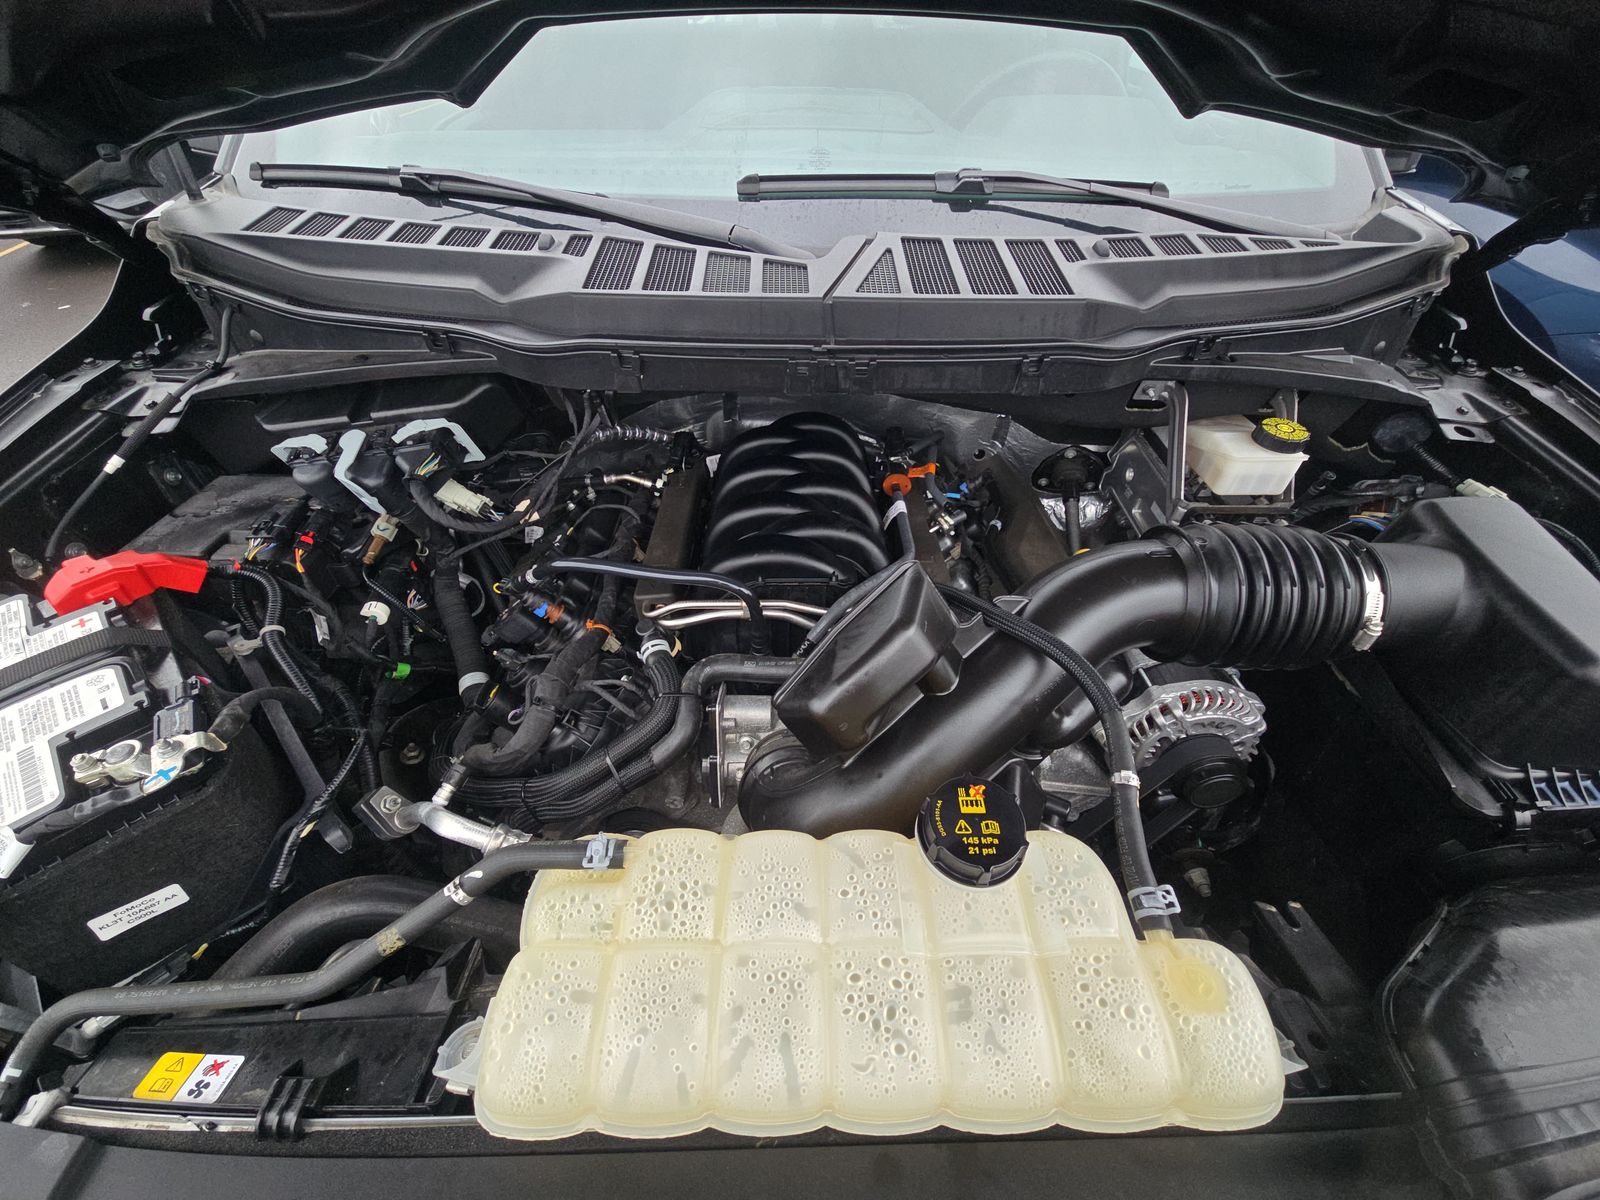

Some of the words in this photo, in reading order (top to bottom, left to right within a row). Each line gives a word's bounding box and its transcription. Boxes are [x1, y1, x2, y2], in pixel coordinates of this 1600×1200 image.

[962, 836, 979, 845] 145
[981, 836, 999, 845] kPa
[968, 846, 980, 855] 21
[982, 847, 997, 856] psi
[164, 893, 178, 902] AA
[113, 897, 156, 918] FoMoCo
